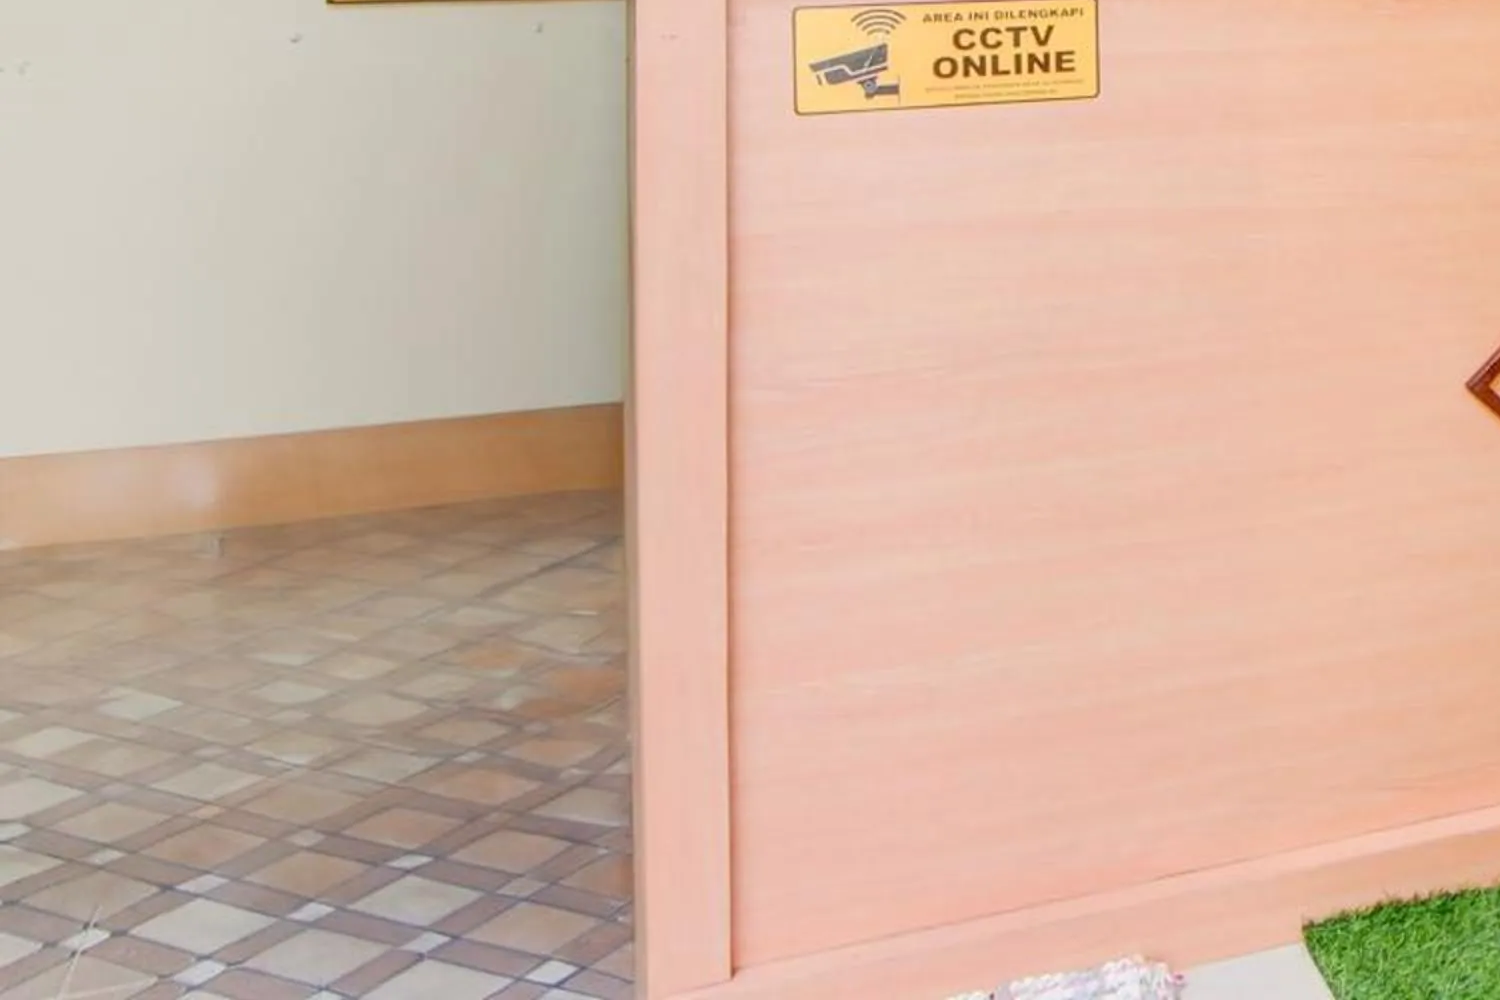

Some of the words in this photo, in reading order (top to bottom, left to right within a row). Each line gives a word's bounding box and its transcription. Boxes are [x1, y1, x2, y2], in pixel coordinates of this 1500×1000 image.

[922, 11, 963, 23] AREA
[968, 9, 989, 21] INI
[994, 7, 1084, 20] DILENGKAPI
[952, 25, 1054, 51] CCTV
[932, 50, 1076, 79] ONLINE
